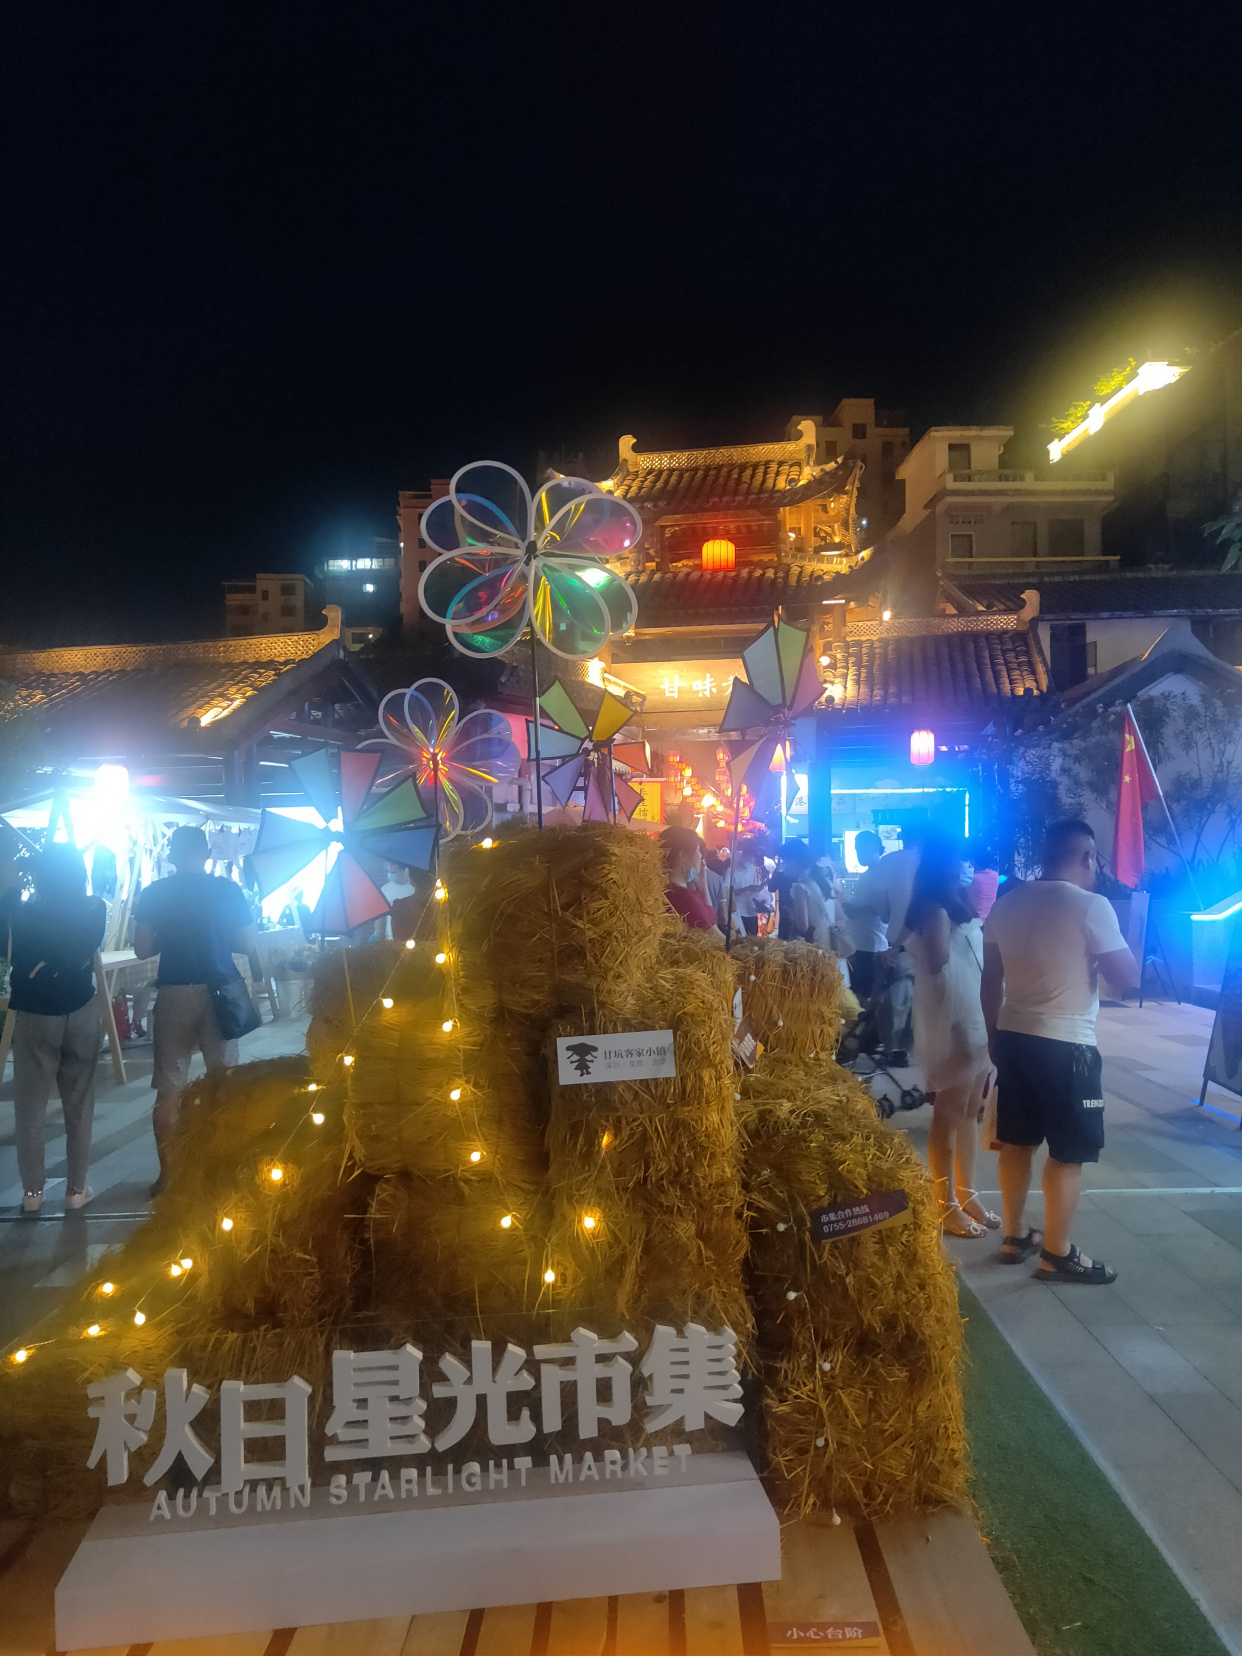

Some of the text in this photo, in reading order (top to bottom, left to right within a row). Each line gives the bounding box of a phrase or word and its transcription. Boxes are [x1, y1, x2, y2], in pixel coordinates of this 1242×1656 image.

[603, 1046, 667, 1060] 甘坑客家小镇
[820, 1204, 870, 1223] 市集合作热线
[822, 1211, 890, 1233] 0755-28681469
[86, 1322, 745, 1493] 秋日星光市集
[149, 1443, 692, 1521] AUTUMN STARLIGHT MARKET
[786, 1627, 864, 1640] 小心台阶
